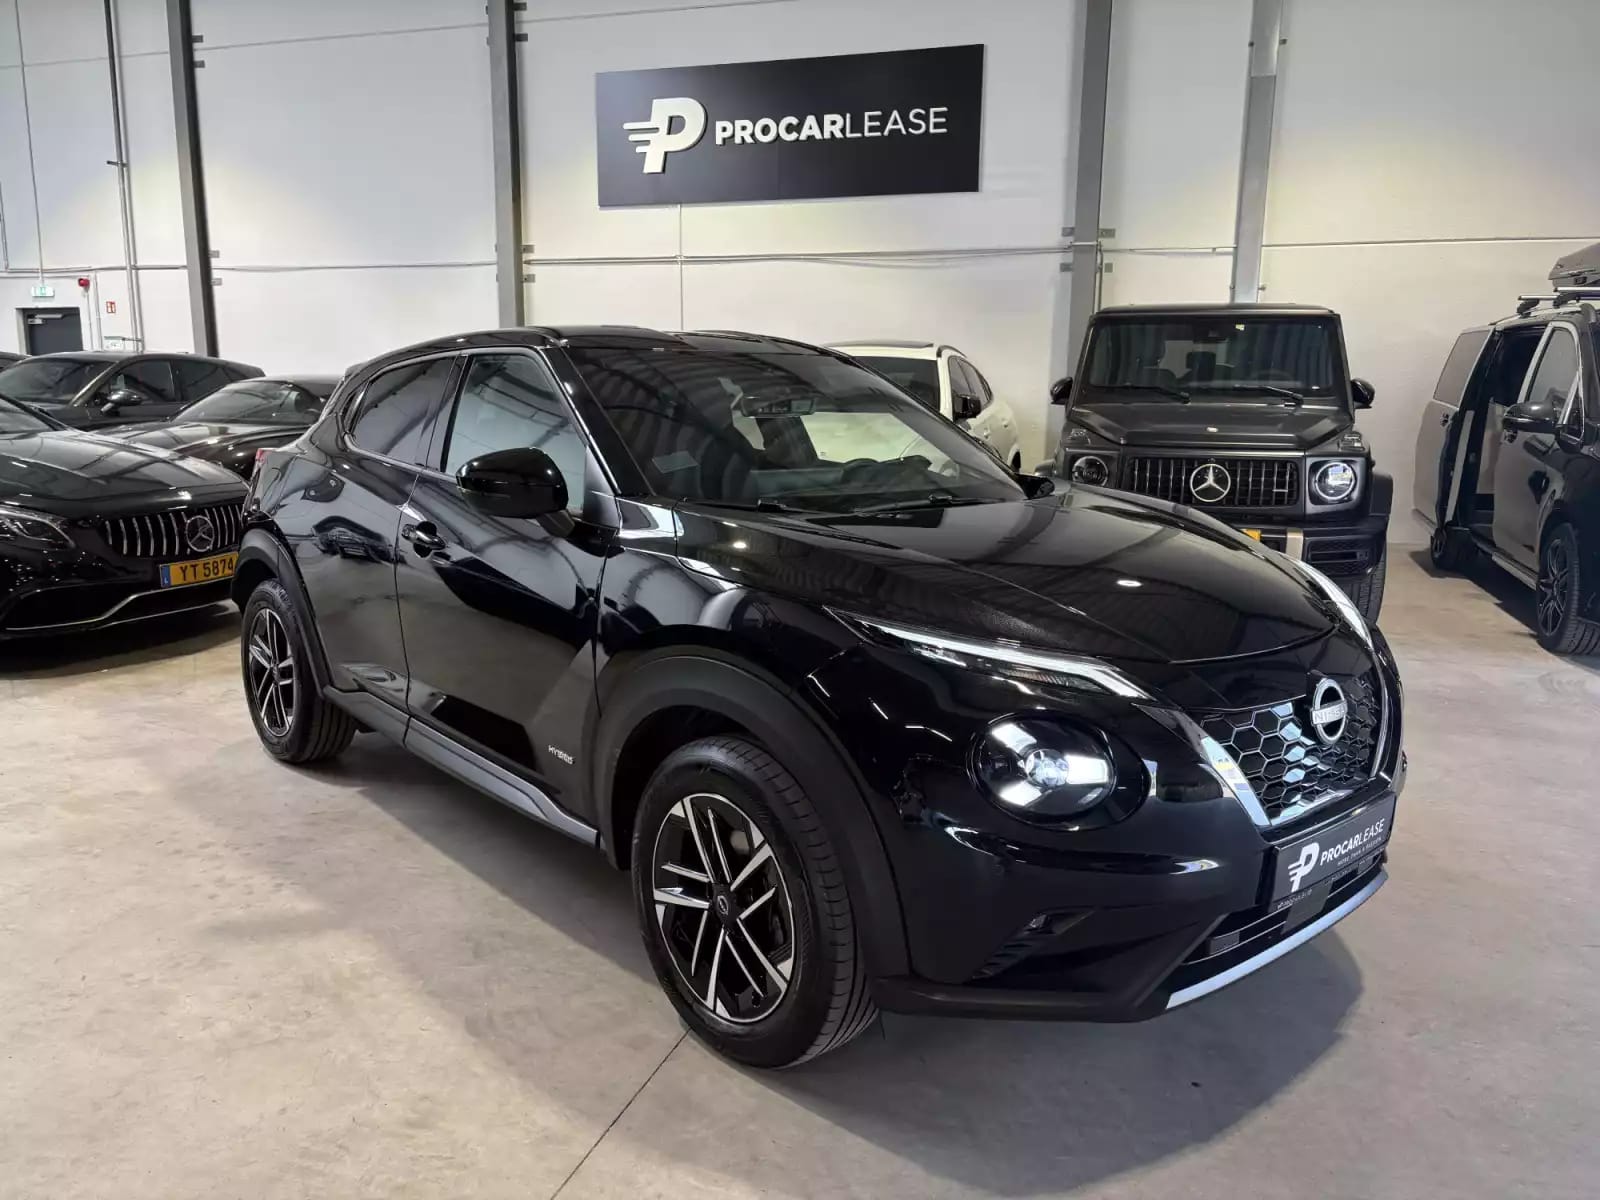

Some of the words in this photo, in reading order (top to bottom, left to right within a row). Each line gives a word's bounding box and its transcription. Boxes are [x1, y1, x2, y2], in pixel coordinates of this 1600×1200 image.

[715, 107, 948, 145] PROCARLEASE
[180, 564, 199, 581] YT
[203, 557, 234, 577] 5874
[1320, 818, 1385, 866] PROCARLEASE
